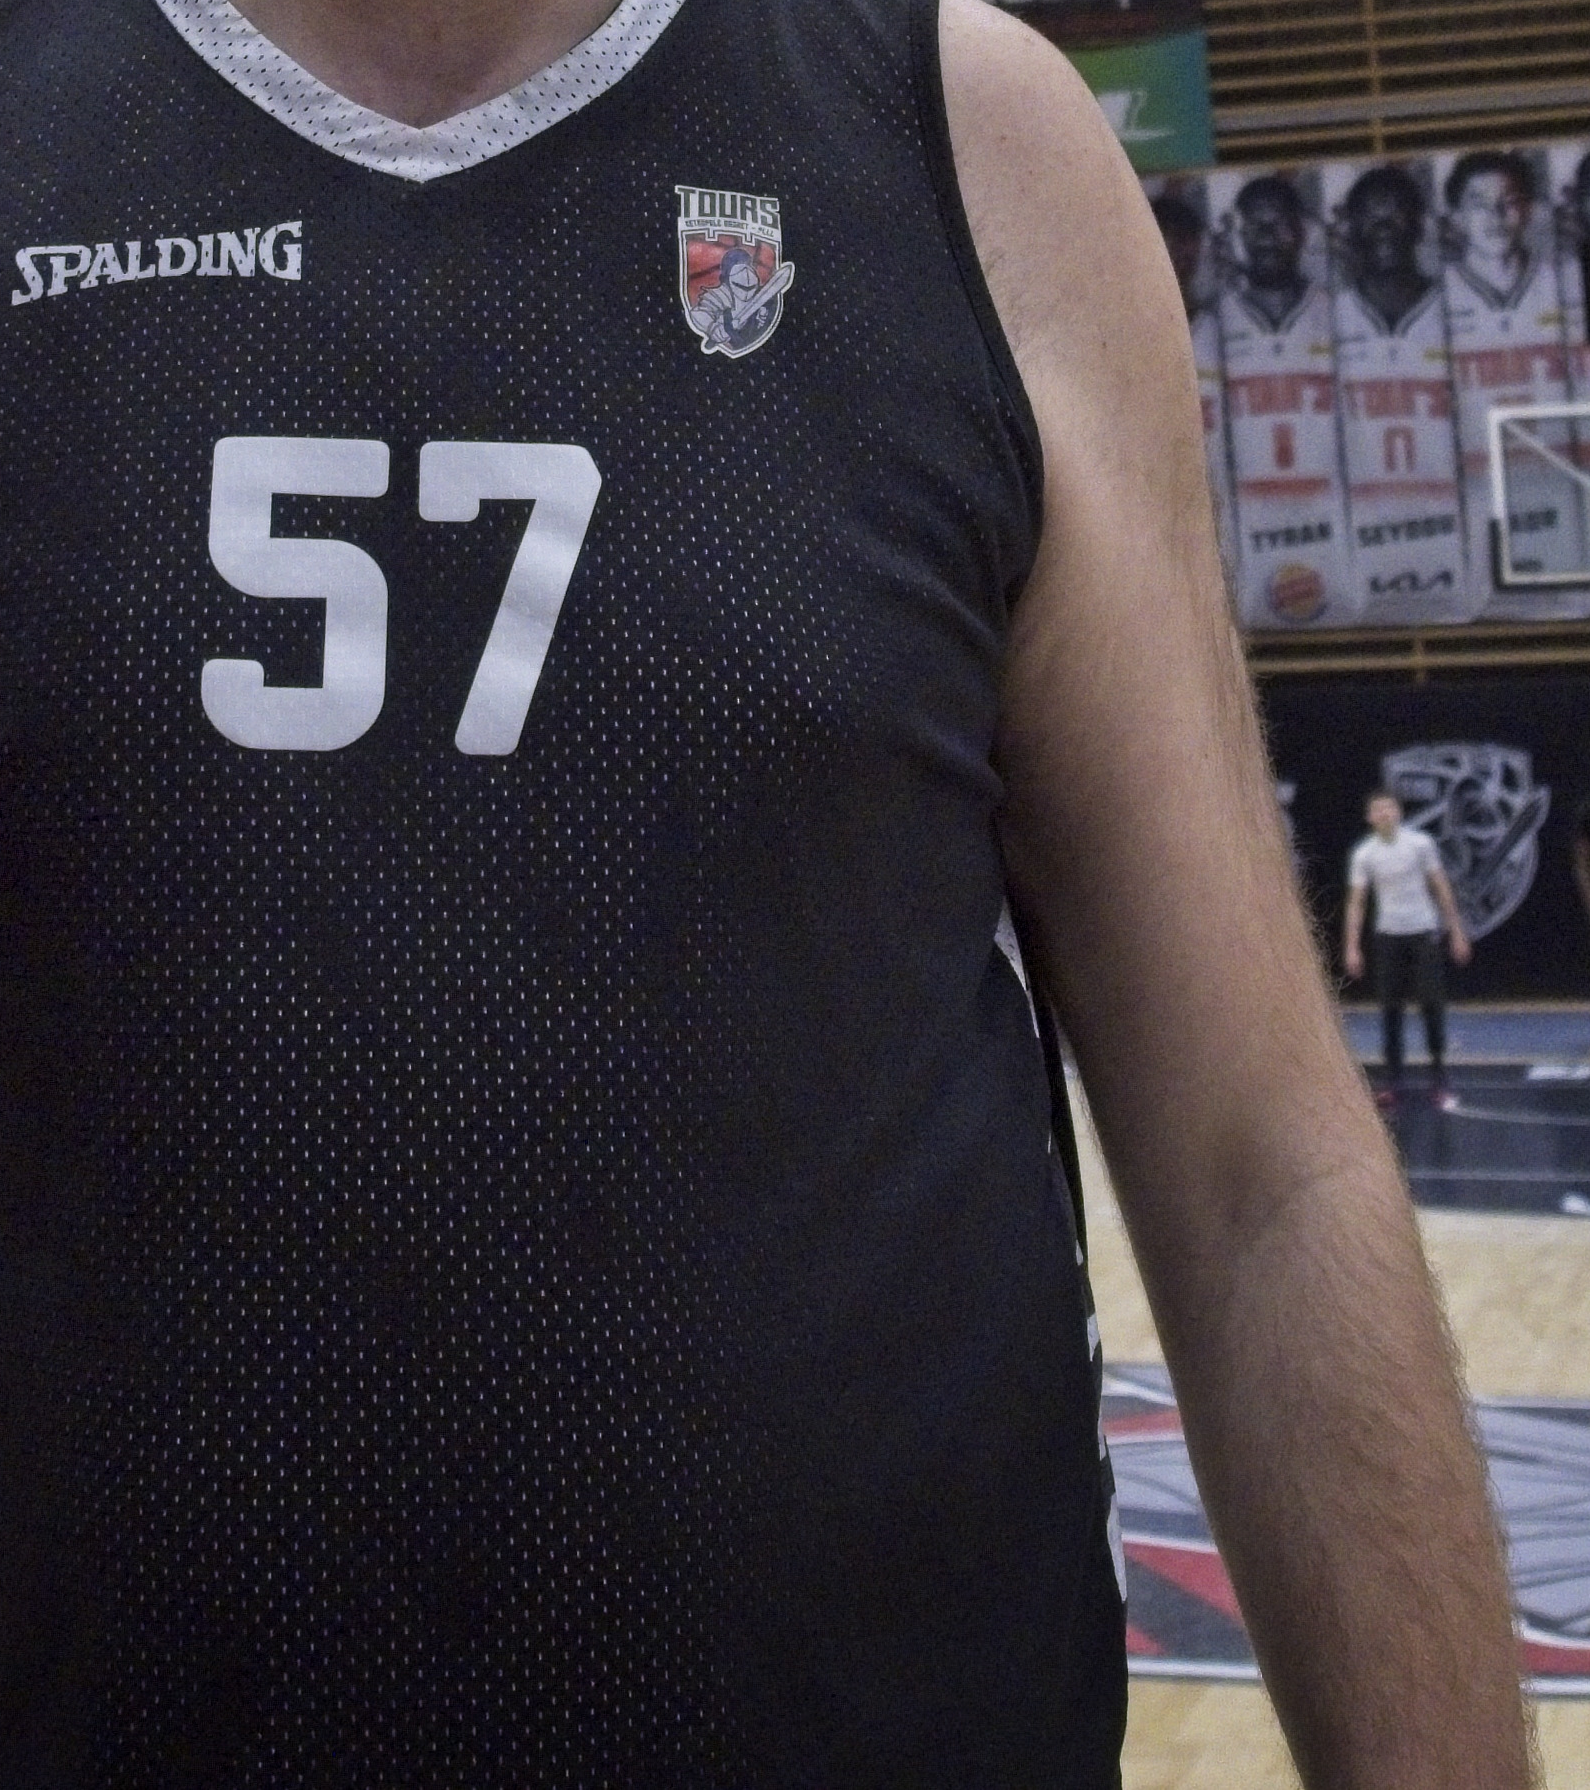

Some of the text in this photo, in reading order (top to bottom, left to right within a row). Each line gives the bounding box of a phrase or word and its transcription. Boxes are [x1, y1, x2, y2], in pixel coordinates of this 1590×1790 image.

[675, 185, 780, 230] TOURS
[11, 220, 303, 307] SPALDING
[201, 436, 603, 756] 57
